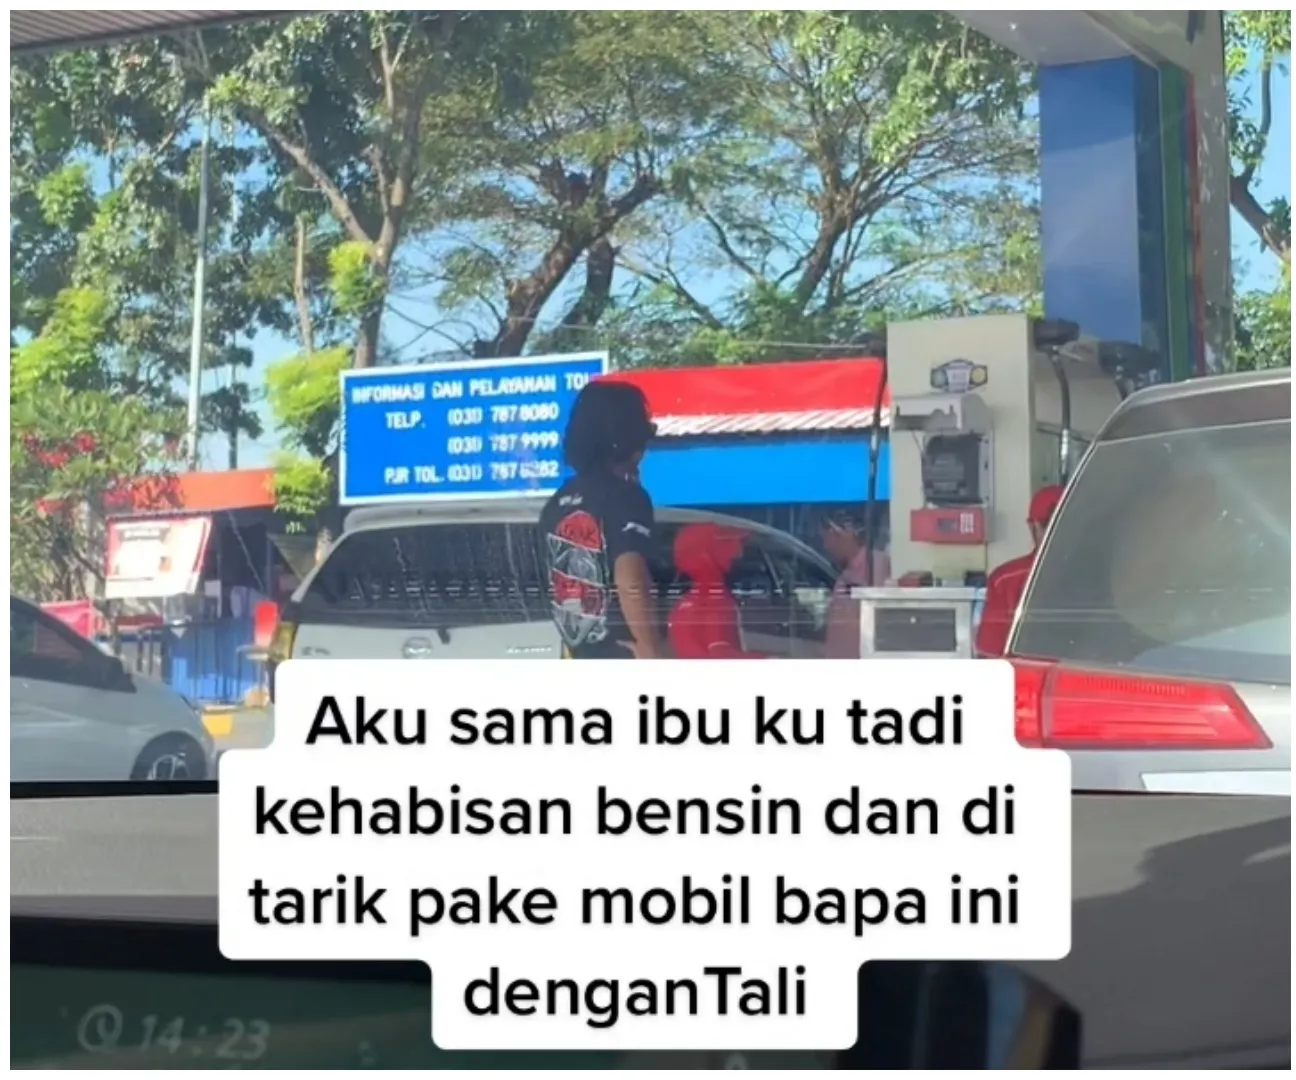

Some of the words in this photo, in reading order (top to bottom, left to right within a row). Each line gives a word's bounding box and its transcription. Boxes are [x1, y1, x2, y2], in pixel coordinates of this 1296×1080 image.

[352, 382, 426, 404] INFORMASI
[432, 380, 464, 400] DAN
[470, 374, 557, 397] PELAYANAN
[385, 409, 426, 430] TELP.
